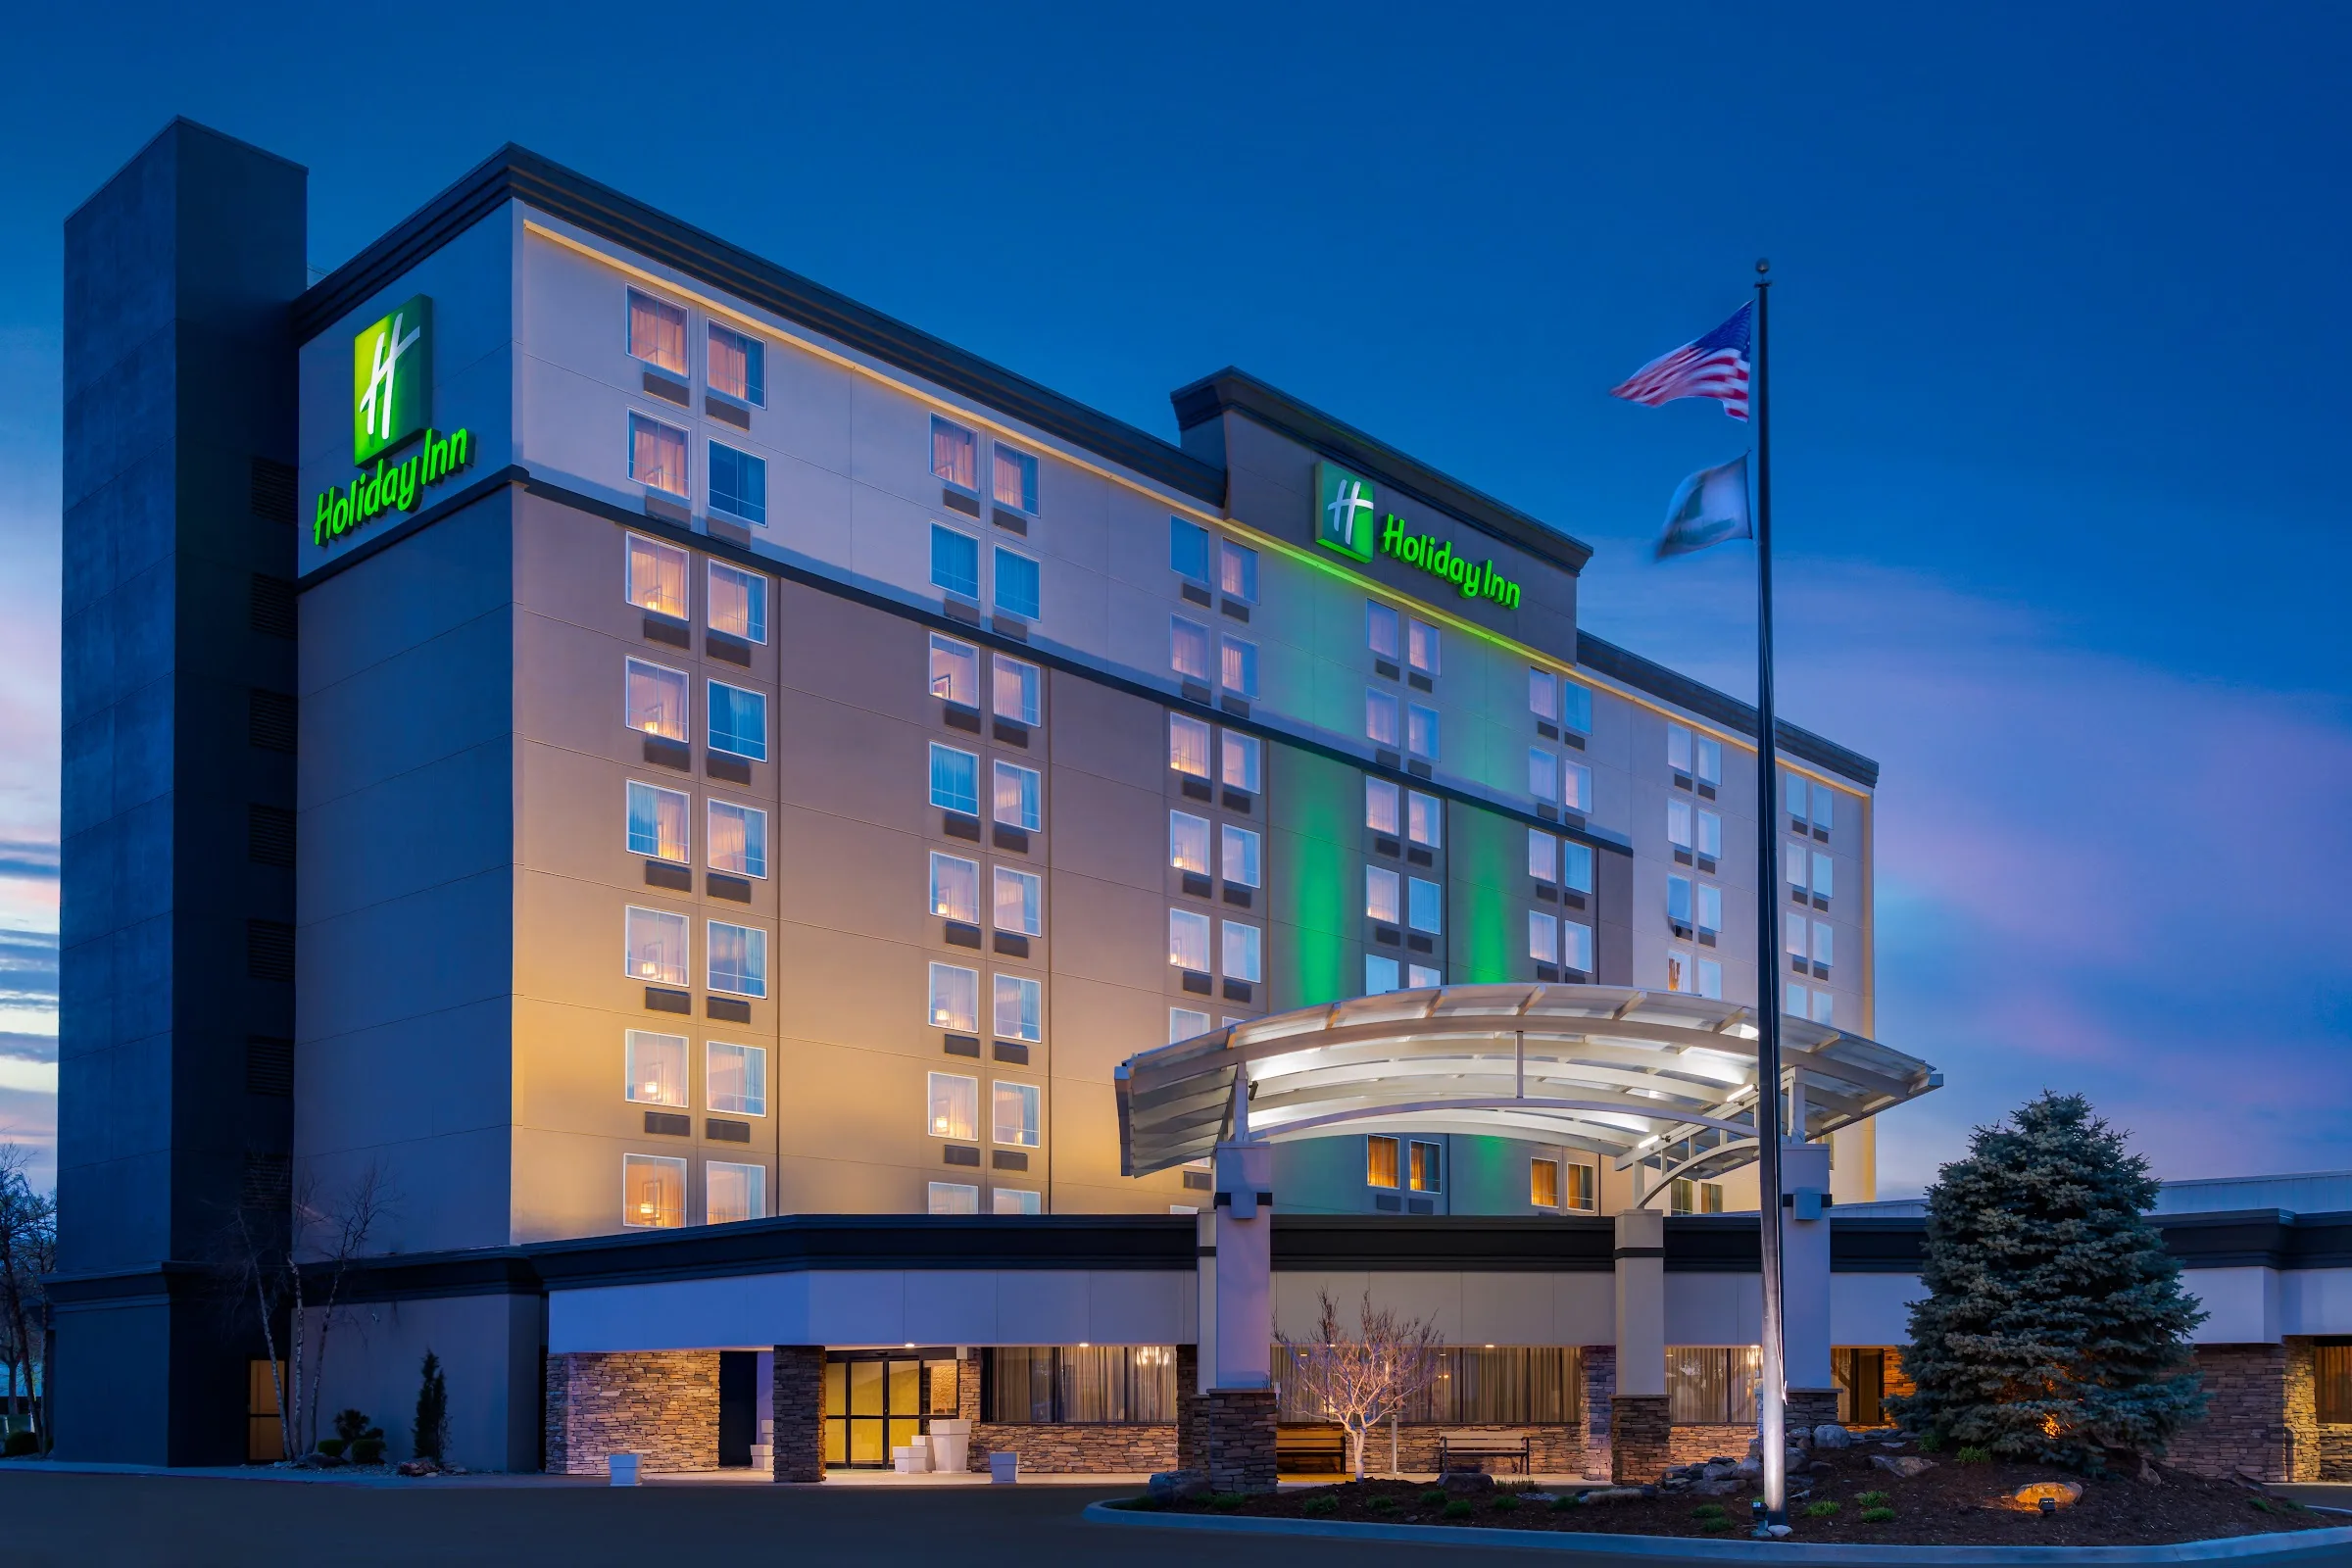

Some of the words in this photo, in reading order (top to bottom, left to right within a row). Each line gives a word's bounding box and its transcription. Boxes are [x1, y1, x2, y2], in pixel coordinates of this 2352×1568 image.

[359, 312, 420, 440] H
[313, 456, 418, 546] Holiday
[421, 427, 468, 486] Inn
[1327, 478, 1374, 546] H
[1381, 513, 1481, 597] Holiday
[1483, 559, 1521, 610] Inn
